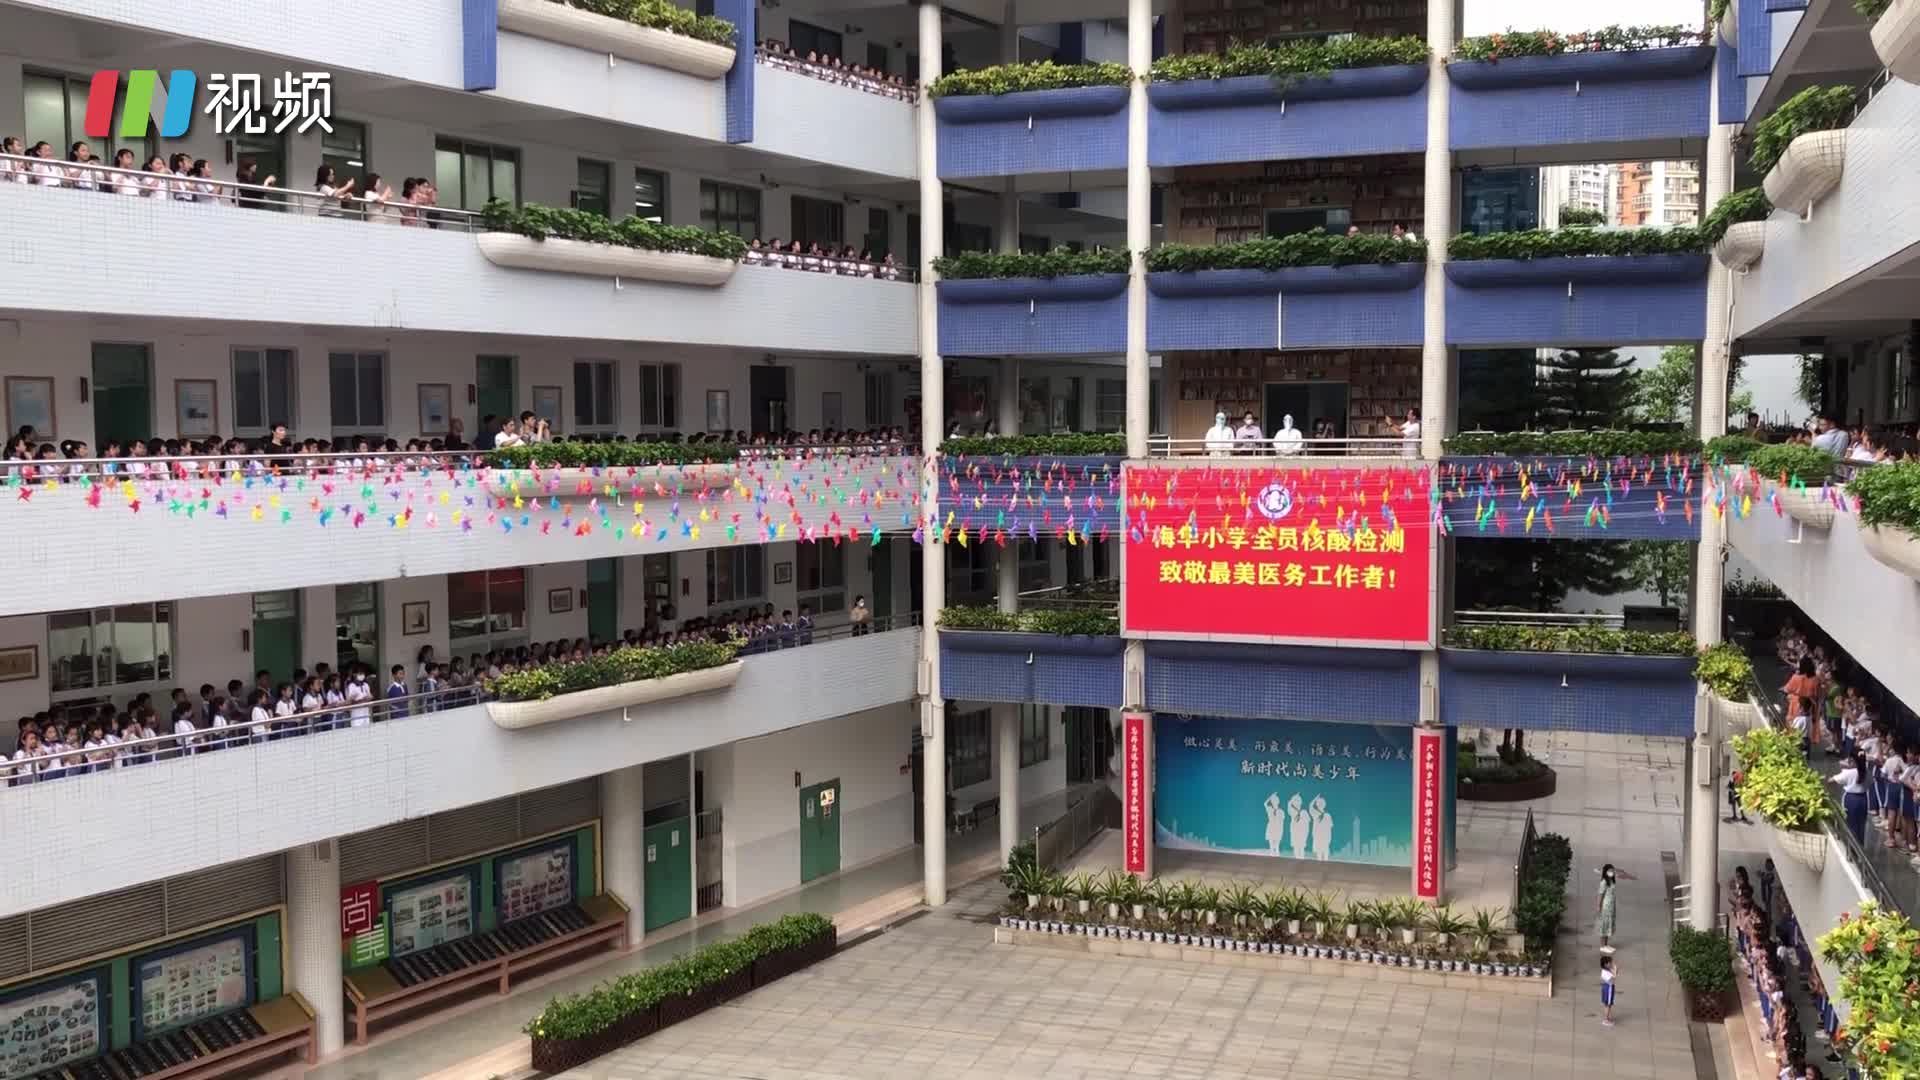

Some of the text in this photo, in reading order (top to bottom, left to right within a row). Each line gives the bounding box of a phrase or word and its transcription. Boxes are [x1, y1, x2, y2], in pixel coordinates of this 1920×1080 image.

[1240, 759, 1361, 781] 新时代尚美少年
